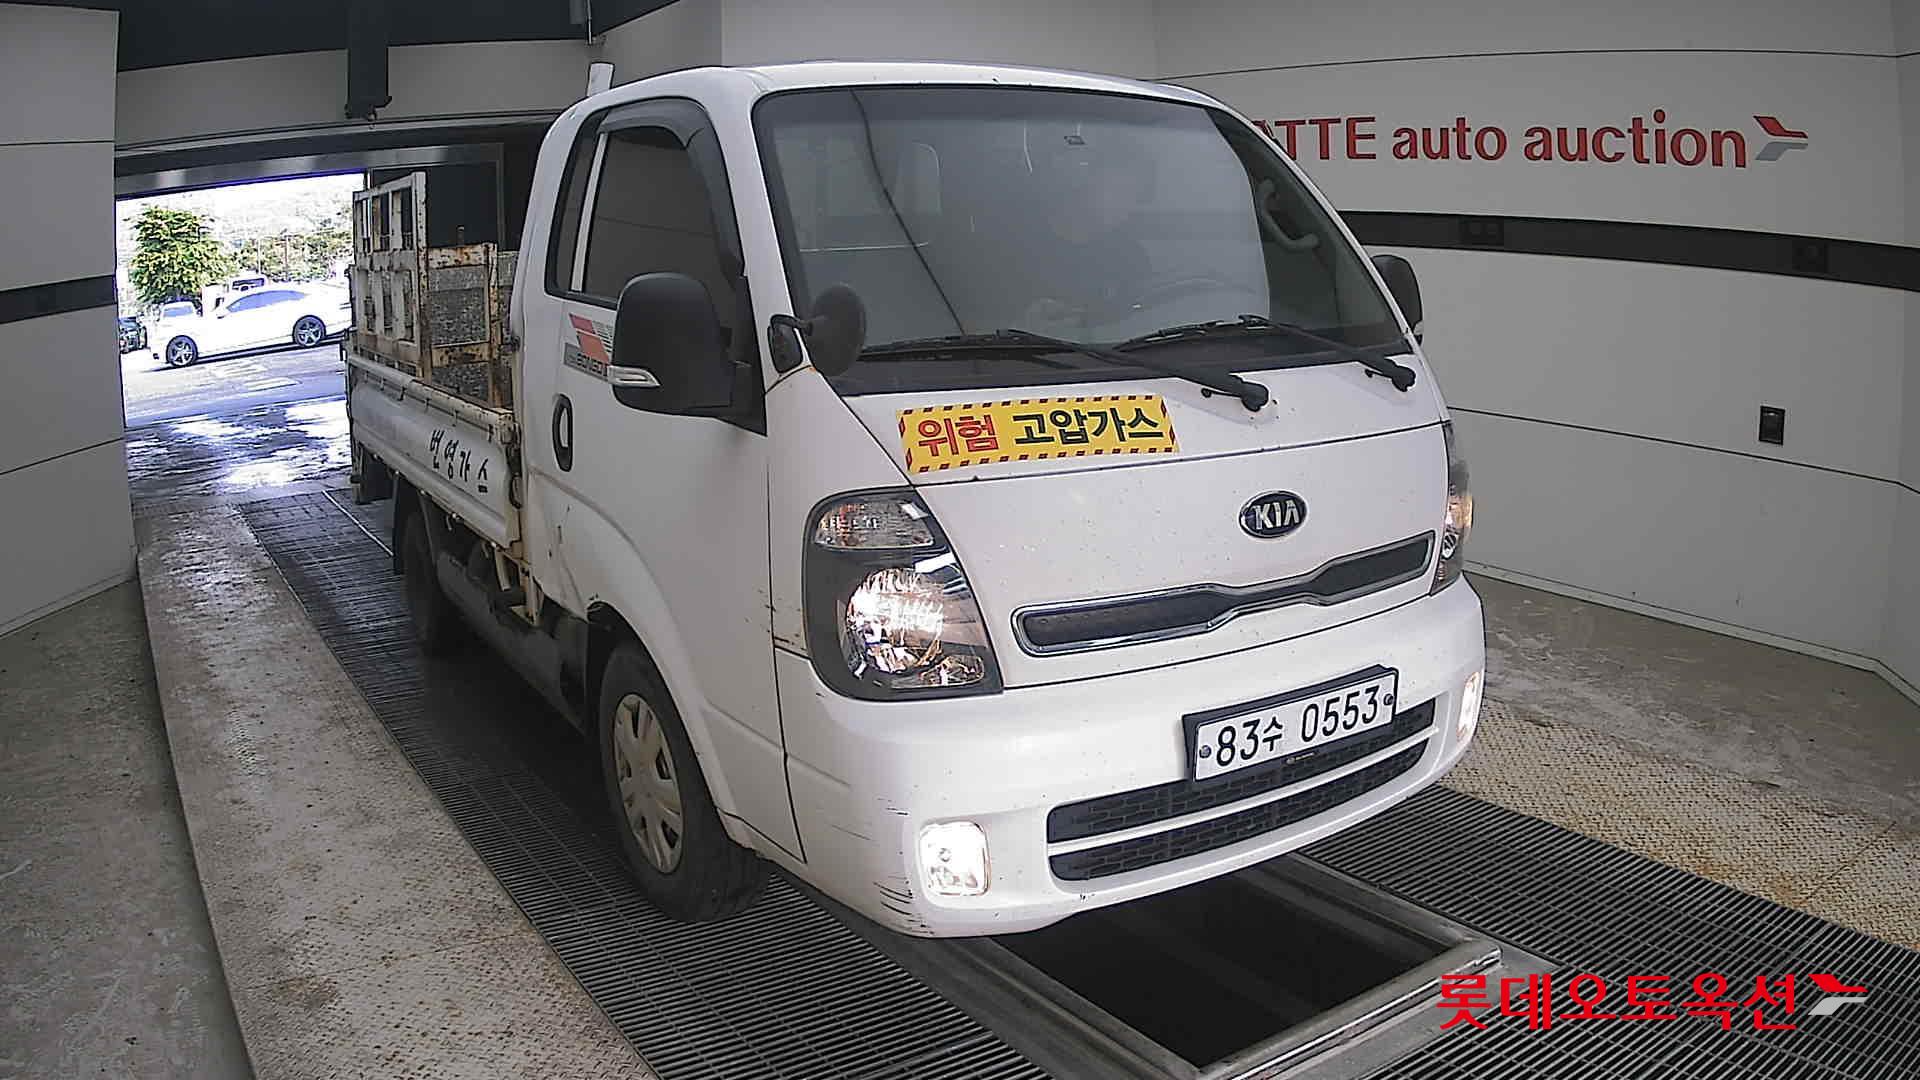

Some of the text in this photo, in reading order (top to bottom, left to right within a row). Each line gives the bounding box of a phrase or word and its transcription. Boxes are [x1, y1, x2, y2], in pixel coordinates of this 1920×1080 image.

[1253, 109, 1747, 169] TTE auto auction
[917, 406, 1164, 457] 위험 고압가스
[1250, 498, 1300, 530] KIA
[1215, 684, 1381, 768] 83수 0553
